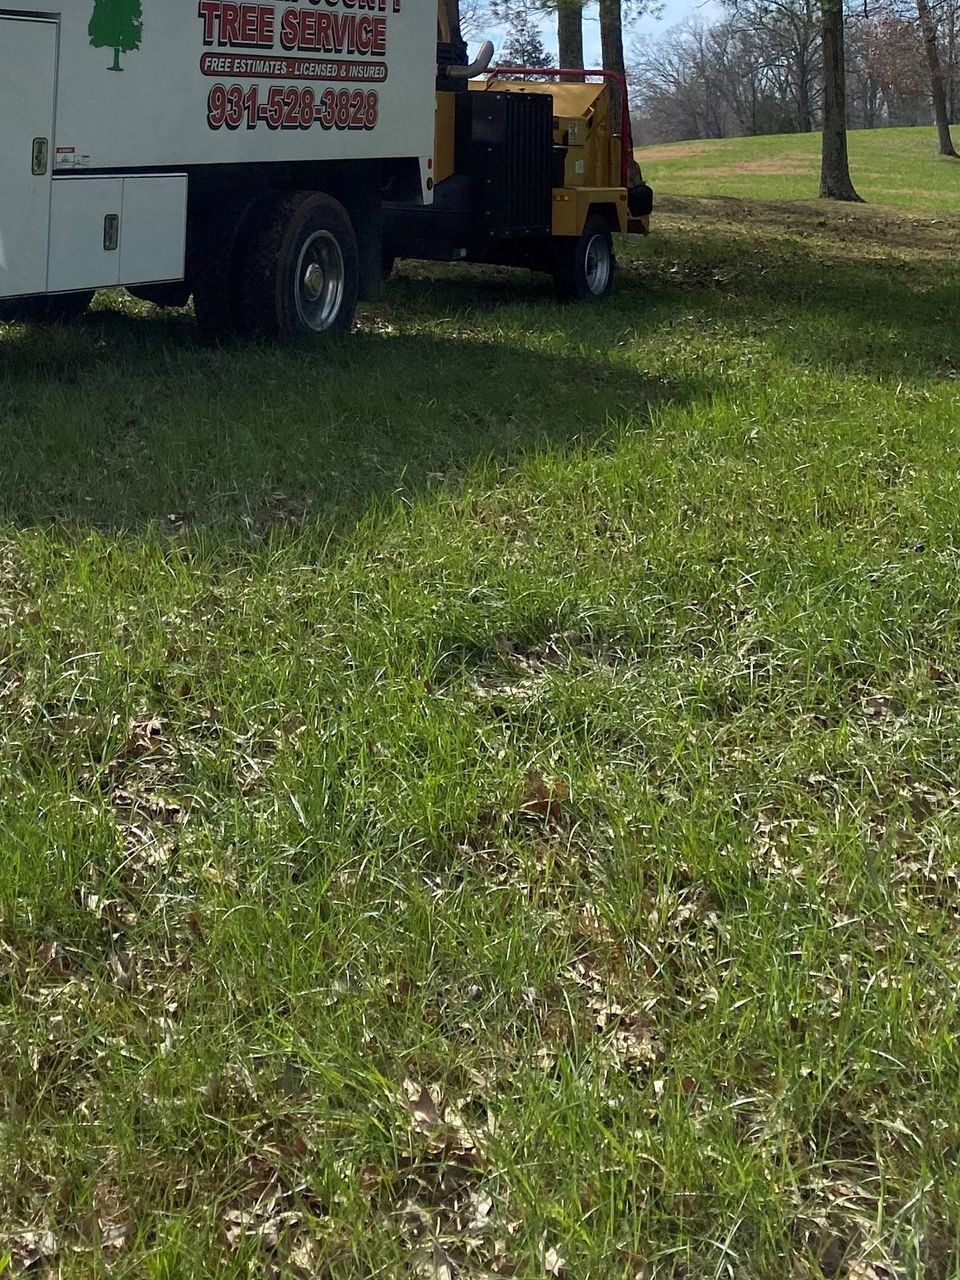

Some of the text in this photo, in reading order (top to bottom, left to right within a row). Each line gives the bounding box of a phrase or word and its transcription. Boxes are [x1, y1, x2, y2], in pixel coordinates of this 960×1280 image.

[198, 0, 387, 56] TREE SERVICE
[204, 57, 231, 72] FREE
[233, 59, 287, 74] ESTIMATES
[294, 62, 338, 77] LICENSED
[340, 65, 347, 77] &
[349, 64, 386, 78] INSURED
[207, 83, 379, 130] 931-528-3828
